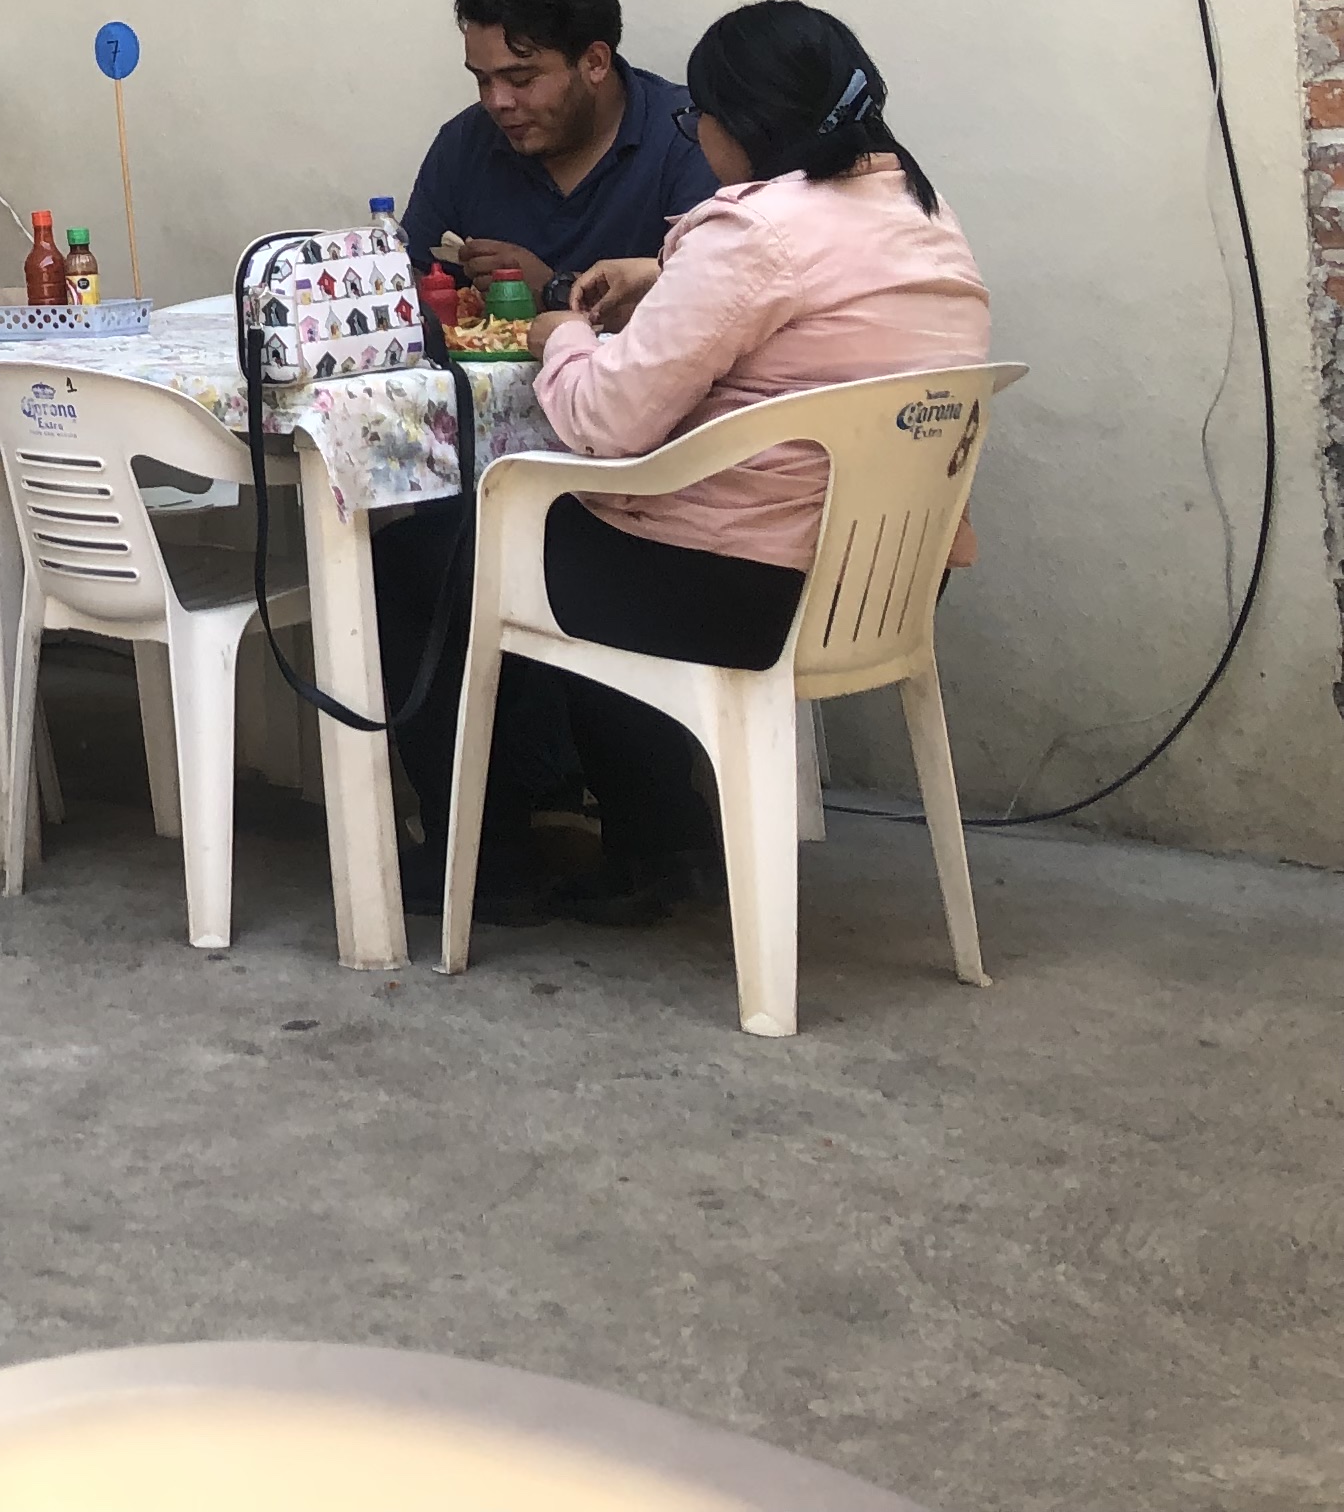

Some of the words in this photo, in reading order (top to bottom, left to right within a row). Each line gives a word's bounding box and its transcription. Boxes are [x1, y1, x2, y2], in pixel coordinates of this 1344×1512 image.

[107, 40, 120, 63] 7
[66, 377, 77, 393] 1
[21, 396, 77, 420] Corona
